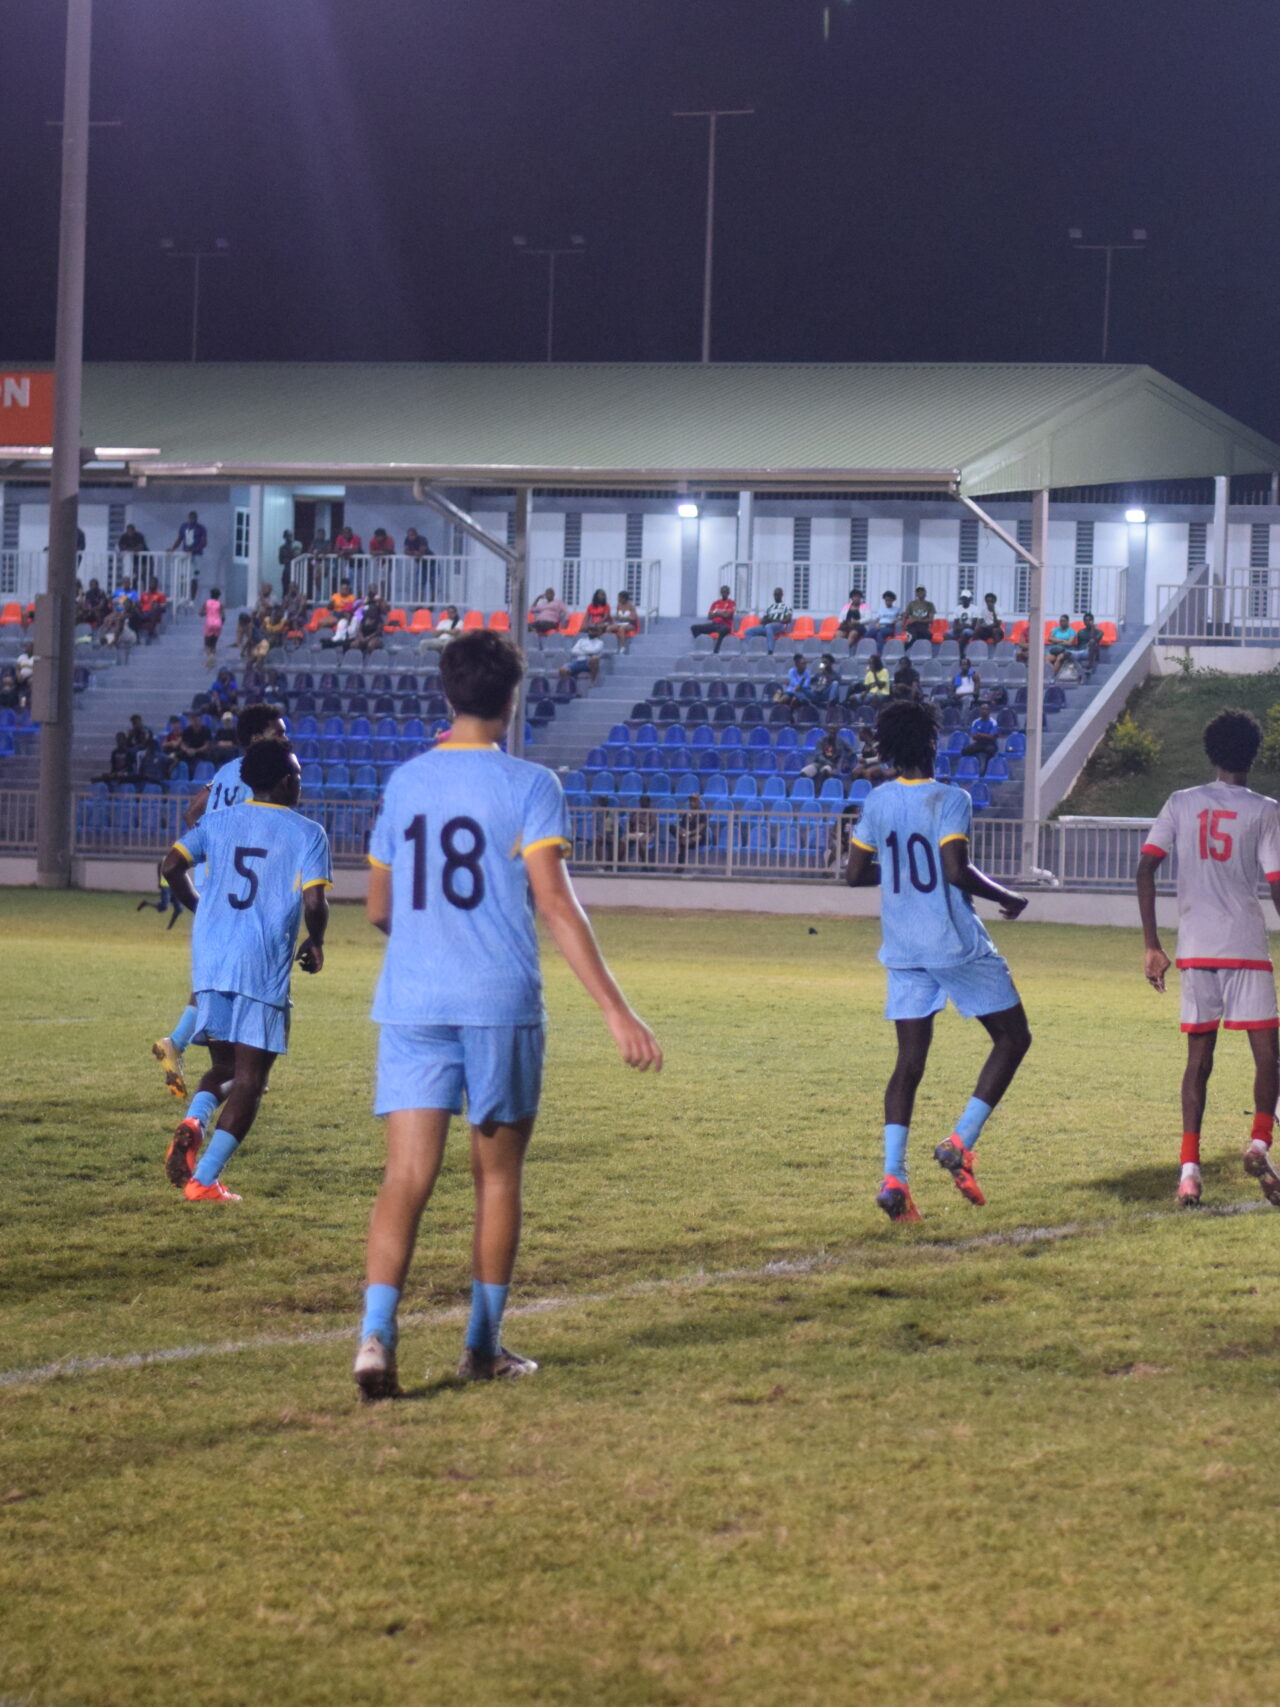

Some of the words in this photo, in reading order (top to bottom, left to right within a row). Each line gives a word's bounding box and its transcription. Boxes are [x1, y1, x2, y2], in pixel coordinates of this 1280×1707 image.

[404, 813, 487, 911] 18
[886, 829, 938, 894] 10
[1196, 808, 1238, 863] 15
[227, 846, 268, 910] 5
